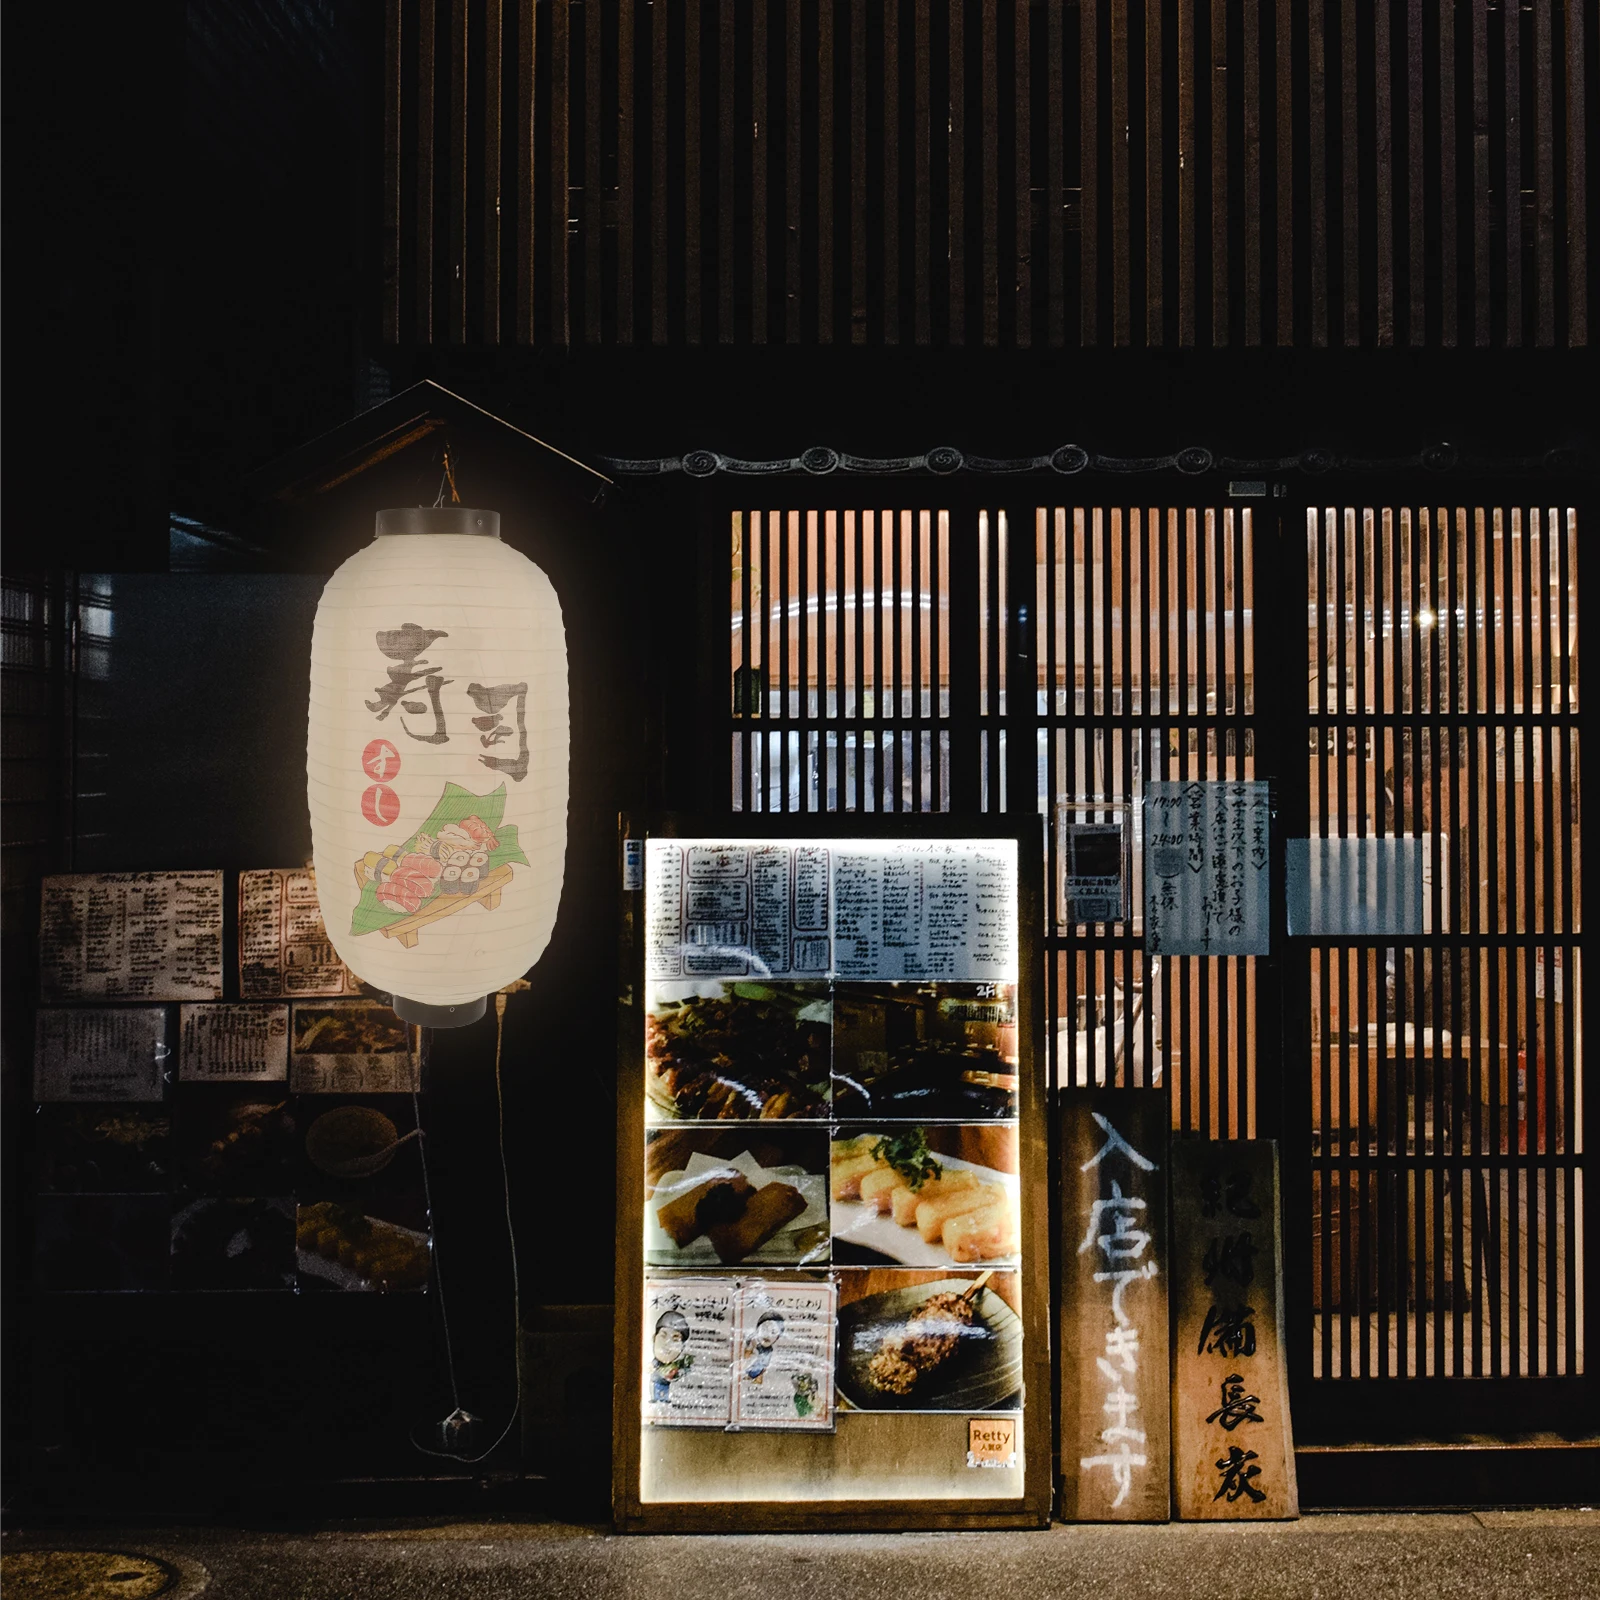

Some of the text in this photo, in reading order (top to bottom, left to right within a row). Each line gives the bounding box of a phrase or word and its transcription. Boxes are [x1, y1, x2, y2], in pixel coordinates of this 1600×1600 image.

[364, 622, 529, 782] 寿司
[363, 742, 399, 825] すし
[1150, 833, 1184, 847] 24:00
[1077, 1111, 1159, 1509] 入店できます
[973, 1429, 1011, 1444] Retty
